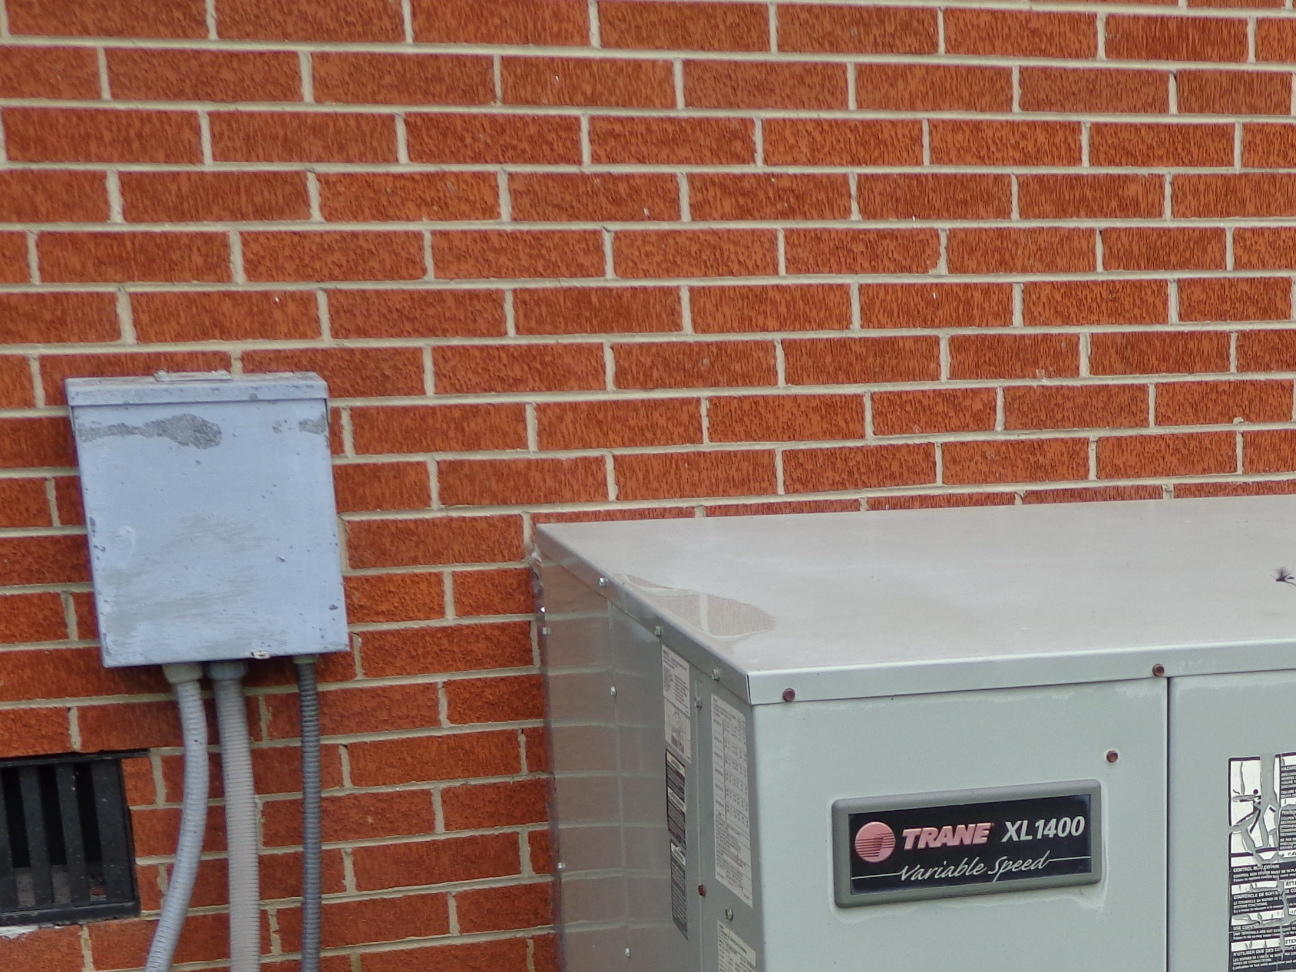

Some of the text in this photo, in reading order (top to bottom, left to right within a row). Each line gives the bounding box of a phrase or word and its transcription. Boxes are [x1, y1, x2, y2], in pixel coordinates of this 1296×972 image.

[902, 815, 1085, 850] TRANE XL1400
[899, 850, 1051, 882] Variable Speed
